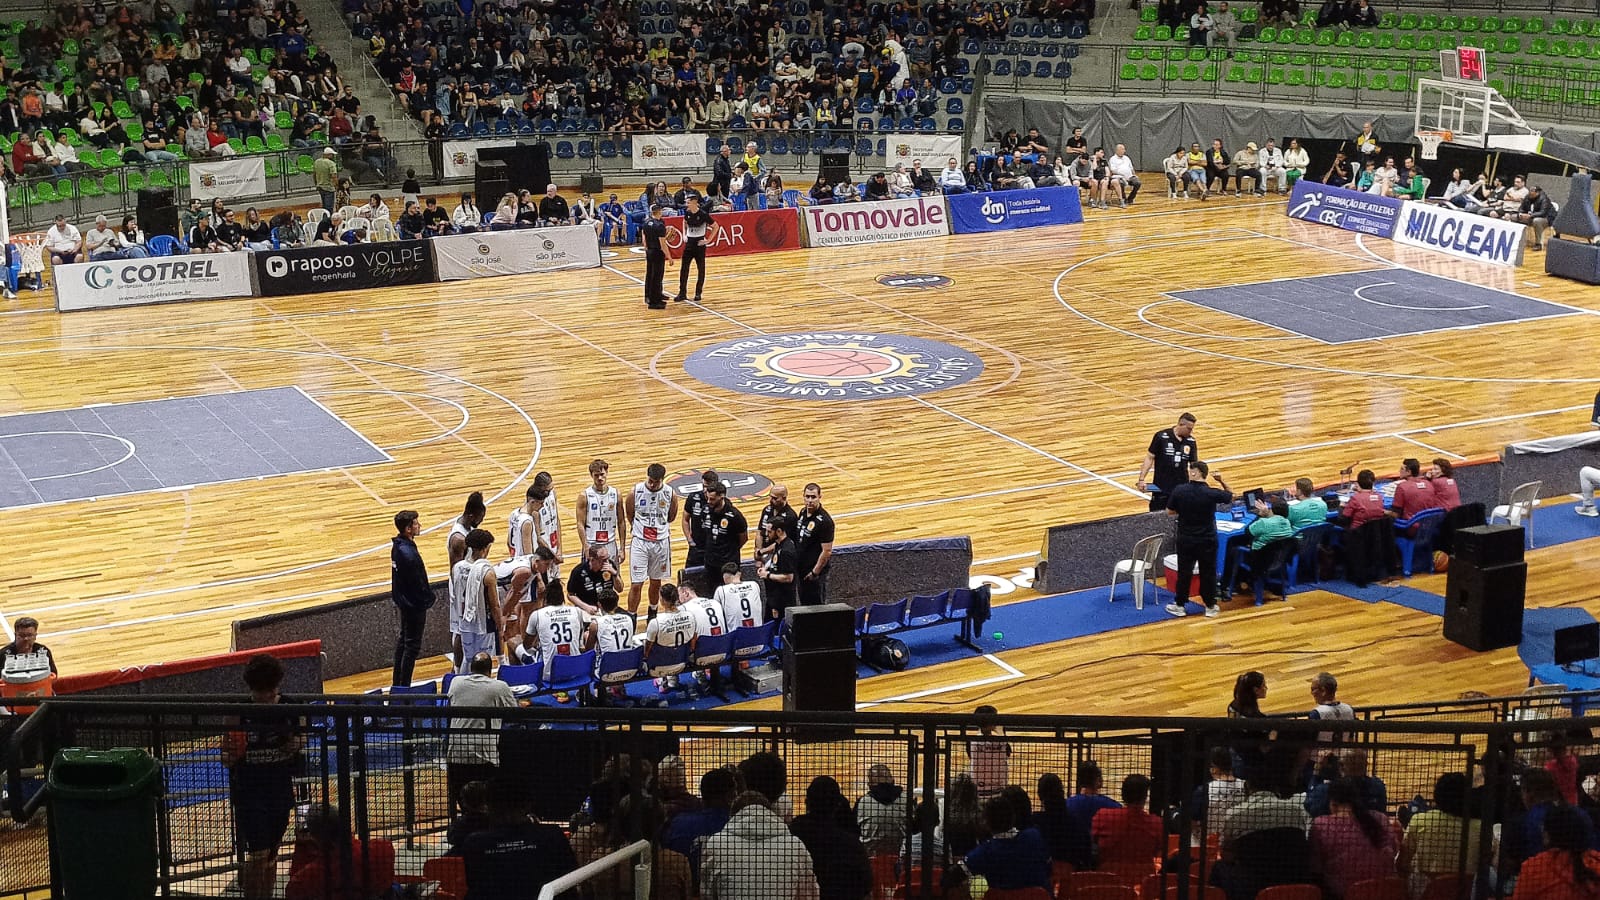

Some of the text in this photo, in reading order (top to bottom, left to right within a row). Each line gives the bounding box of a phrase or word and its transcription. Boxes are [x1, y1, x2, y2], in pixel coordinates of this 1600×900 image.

[1461, 59, 1482, 80] 24
[809, 199, 943, 232] Tomovale
[981, 196, 1006, 215] dm
[1325, 195, 1396, 216] FORMAÇÃO DE ATLETAS
[1319, 209, 1343, 226] CBC
[1405, 208, 1516, 262] MILCLEAN
[290, 255, 355, 273] raposo
[361, 246, 425, 267] VOLPE
[120, 259, 218, 284] COTREL
[312, 270, 356, 282] engenharia
[736, 380, 847, 396] CAMPOS
[855, 383, 914, 396] DOS
[677, 476, 757, 494] FB
[705, 607, 719, 626] 8
[740, 598, 752, 618] 9
[550, 622, 572, 644] 35
[611, 629, 631, 650] 12
